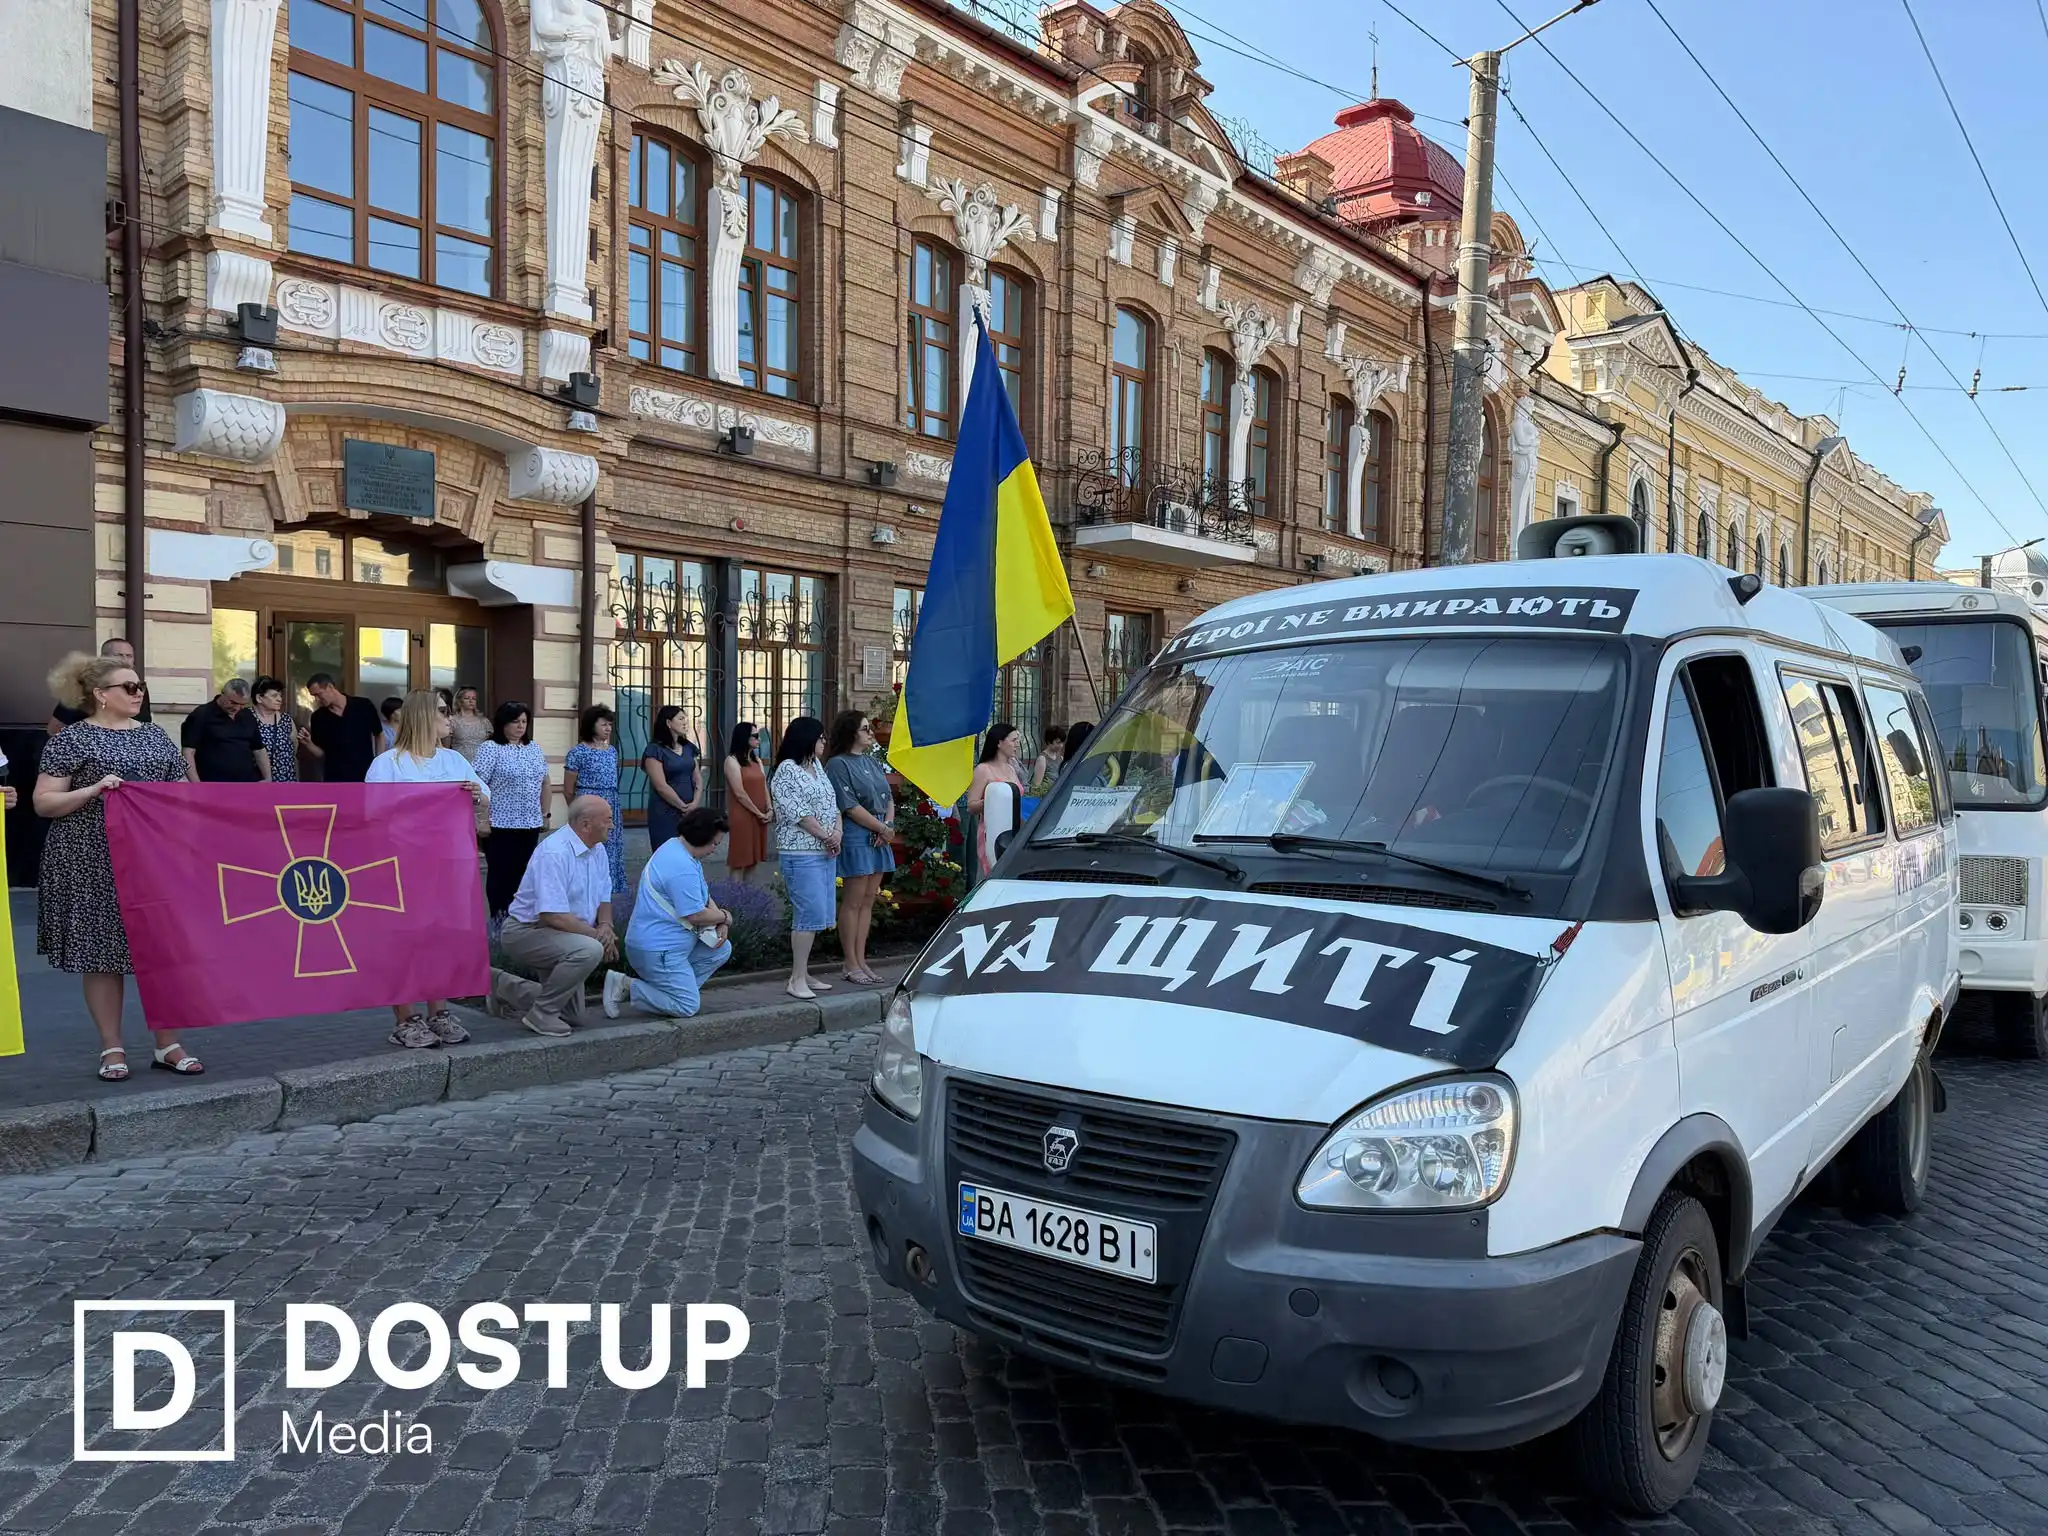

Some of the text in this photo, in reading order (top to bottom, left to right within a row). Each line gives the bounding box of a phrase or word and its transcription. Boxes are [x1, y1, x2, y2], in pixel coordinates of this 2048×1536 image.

[1342, 595, 1622, 623] ВМИРАЮТЬ
[1088, 915, 1478, 1036] ЩИТІ
[962, 1214, 975, 1228] UA
[977, 1195, 1015, 1239] BA
[1025, 1207, 1090, 1256] 1628
